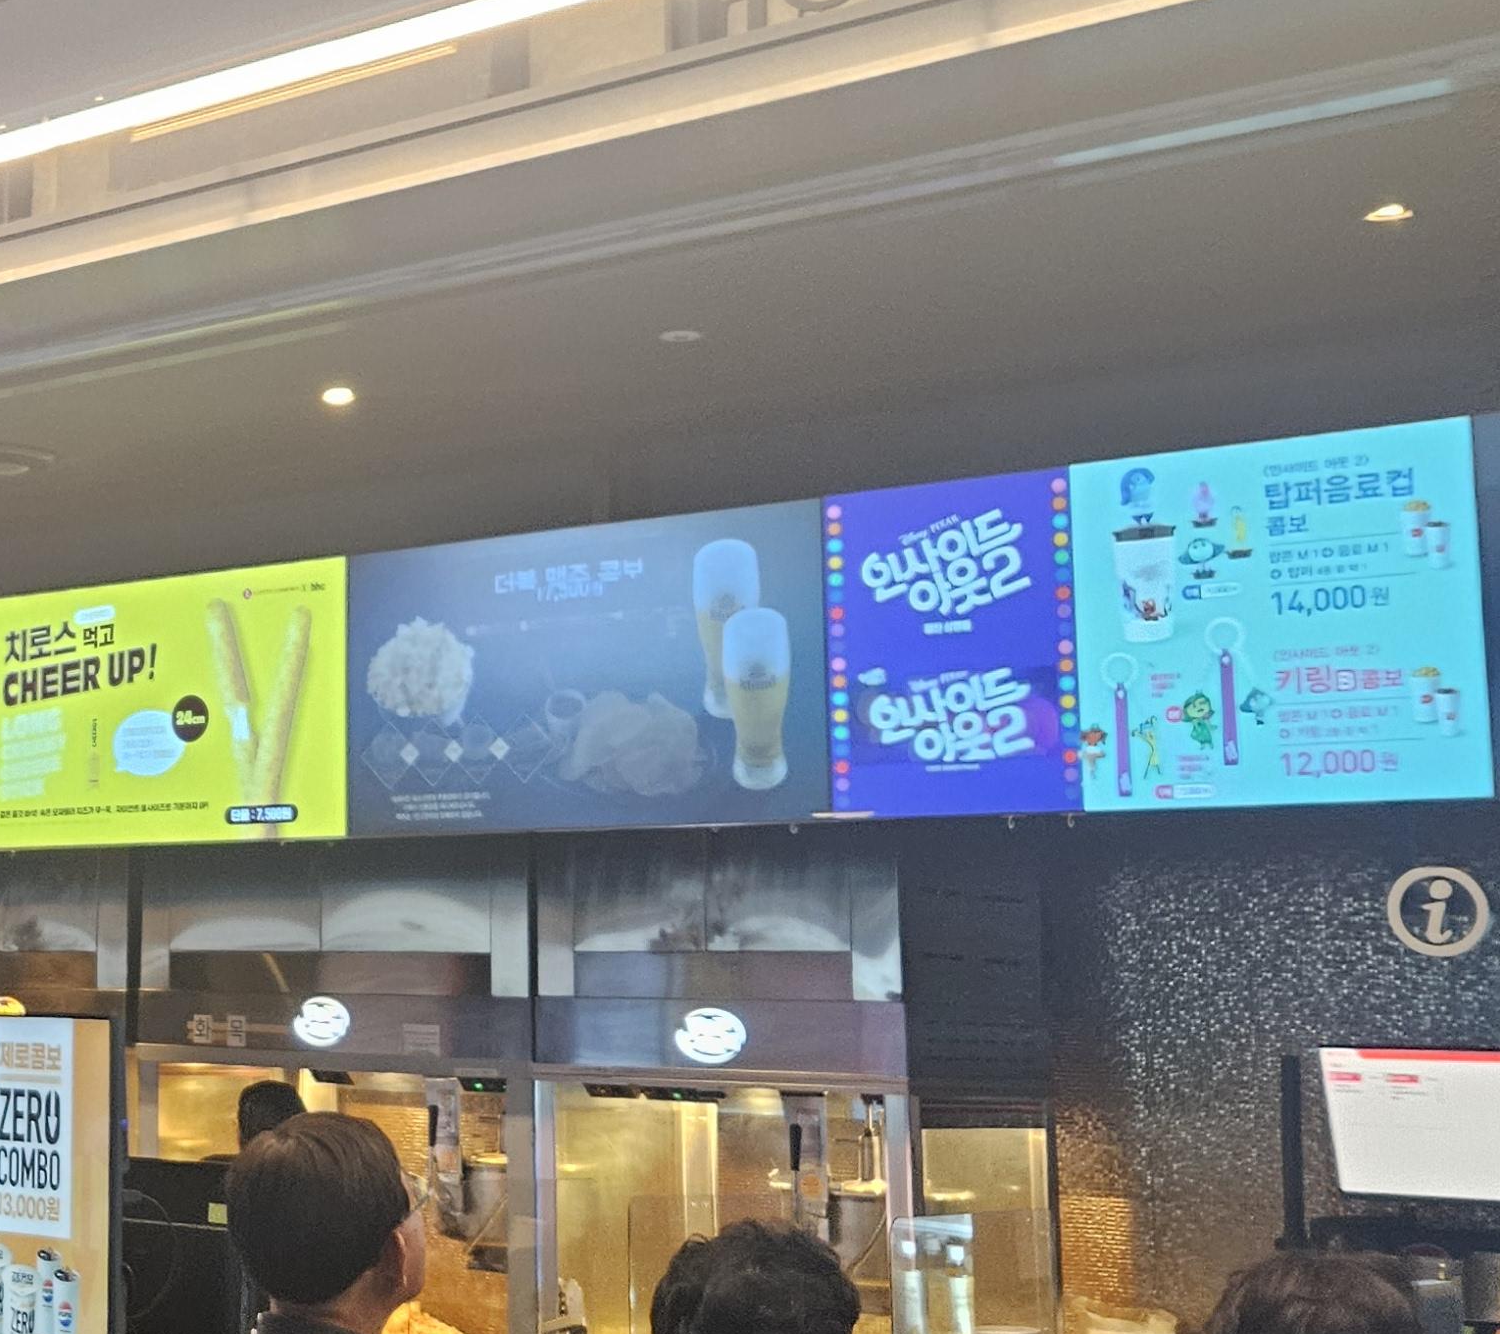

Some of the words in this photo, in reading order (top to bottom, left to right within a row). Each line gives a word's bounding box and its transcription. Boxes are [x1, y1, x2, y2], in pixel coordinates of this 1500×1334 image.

[1264, 467, 1415, 510] 탑퍼음료컵
[1266, 514, 1309, 537] 콤보
[1270, 584, 1391, 617] 14,000원
[4, 620, 77, 665] 치로스
[83, 623, 116, 650] 먹고
[2, 655, 102, 706] CHEER
[108, 643, 158, 688] UP!
[0, 1041, 62, 1071] 제로콤보
